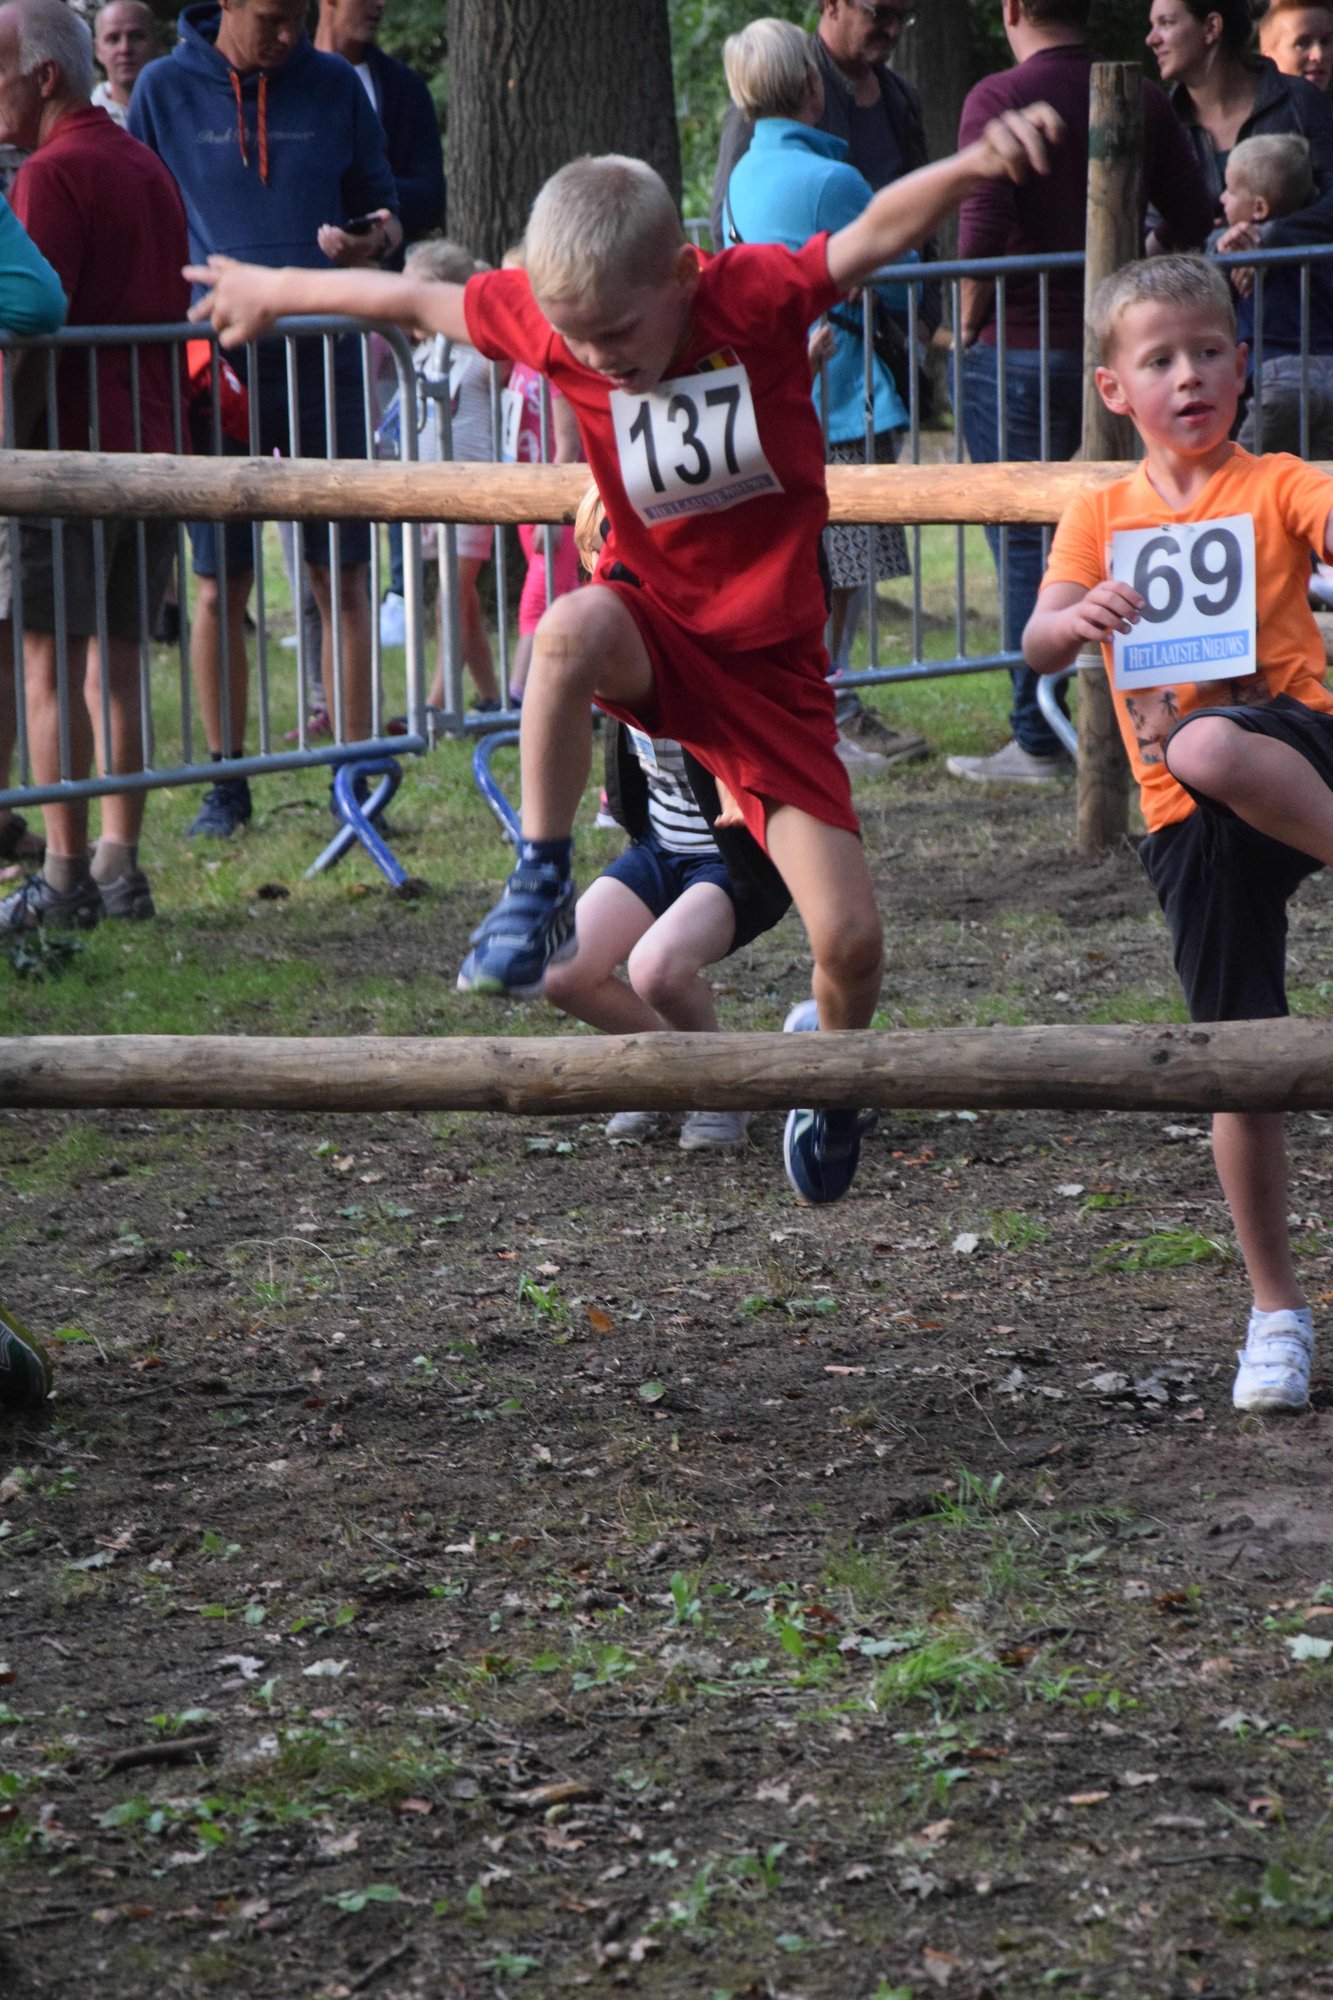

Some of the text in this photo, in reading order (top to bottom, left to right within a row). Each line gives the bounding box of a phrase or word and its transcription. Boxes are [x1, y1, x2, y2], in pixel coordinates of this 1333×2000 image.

[629, 384, 741, 493] 137
[1134, 527, 1243, 623] 69
[1129, 635, 1245, 669] HET LAATSTE NIEUWS
